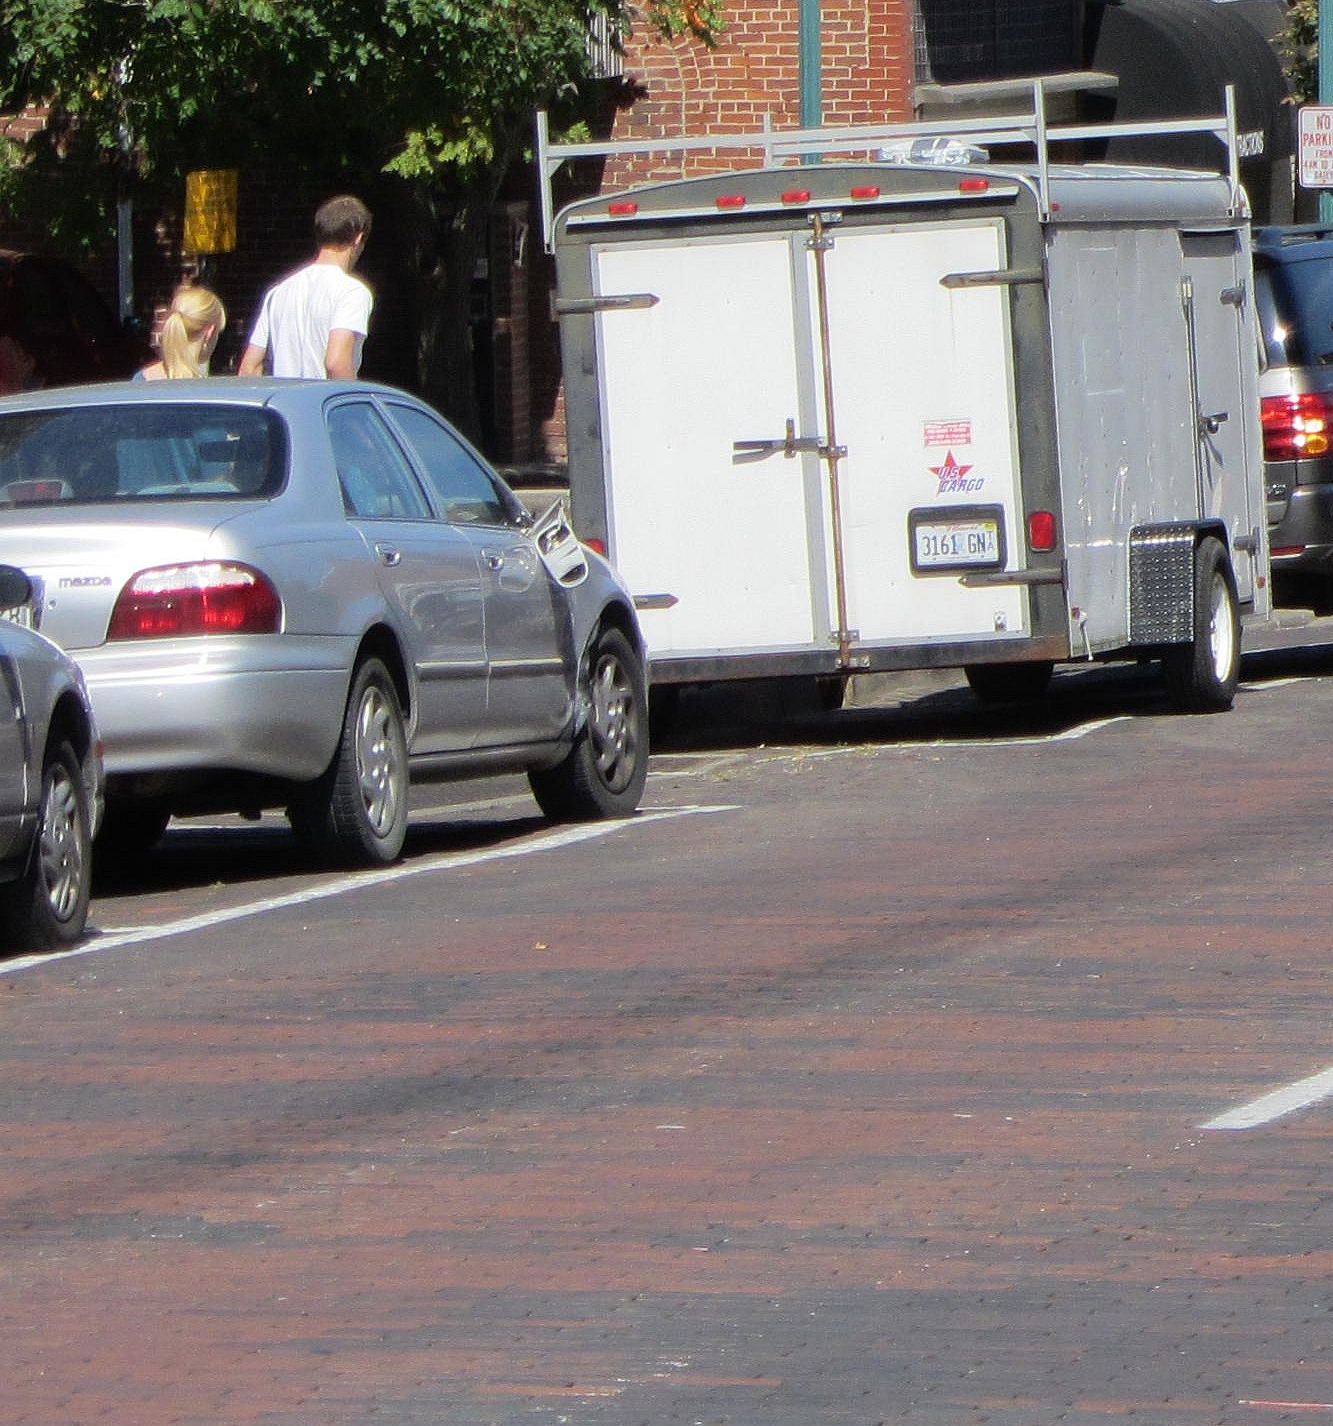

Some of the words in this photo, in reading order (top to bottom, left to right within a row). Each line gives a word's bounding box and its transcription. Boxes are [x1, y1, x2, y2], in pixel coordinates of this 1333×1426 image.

[1316, 115, 1331, 130] NO
[940, 478, 986, 493] CARGO
[922, 535, 959, 556] 3161
[968, 532, 986, 554] GN
[59, 577, 112, 588] mazda
